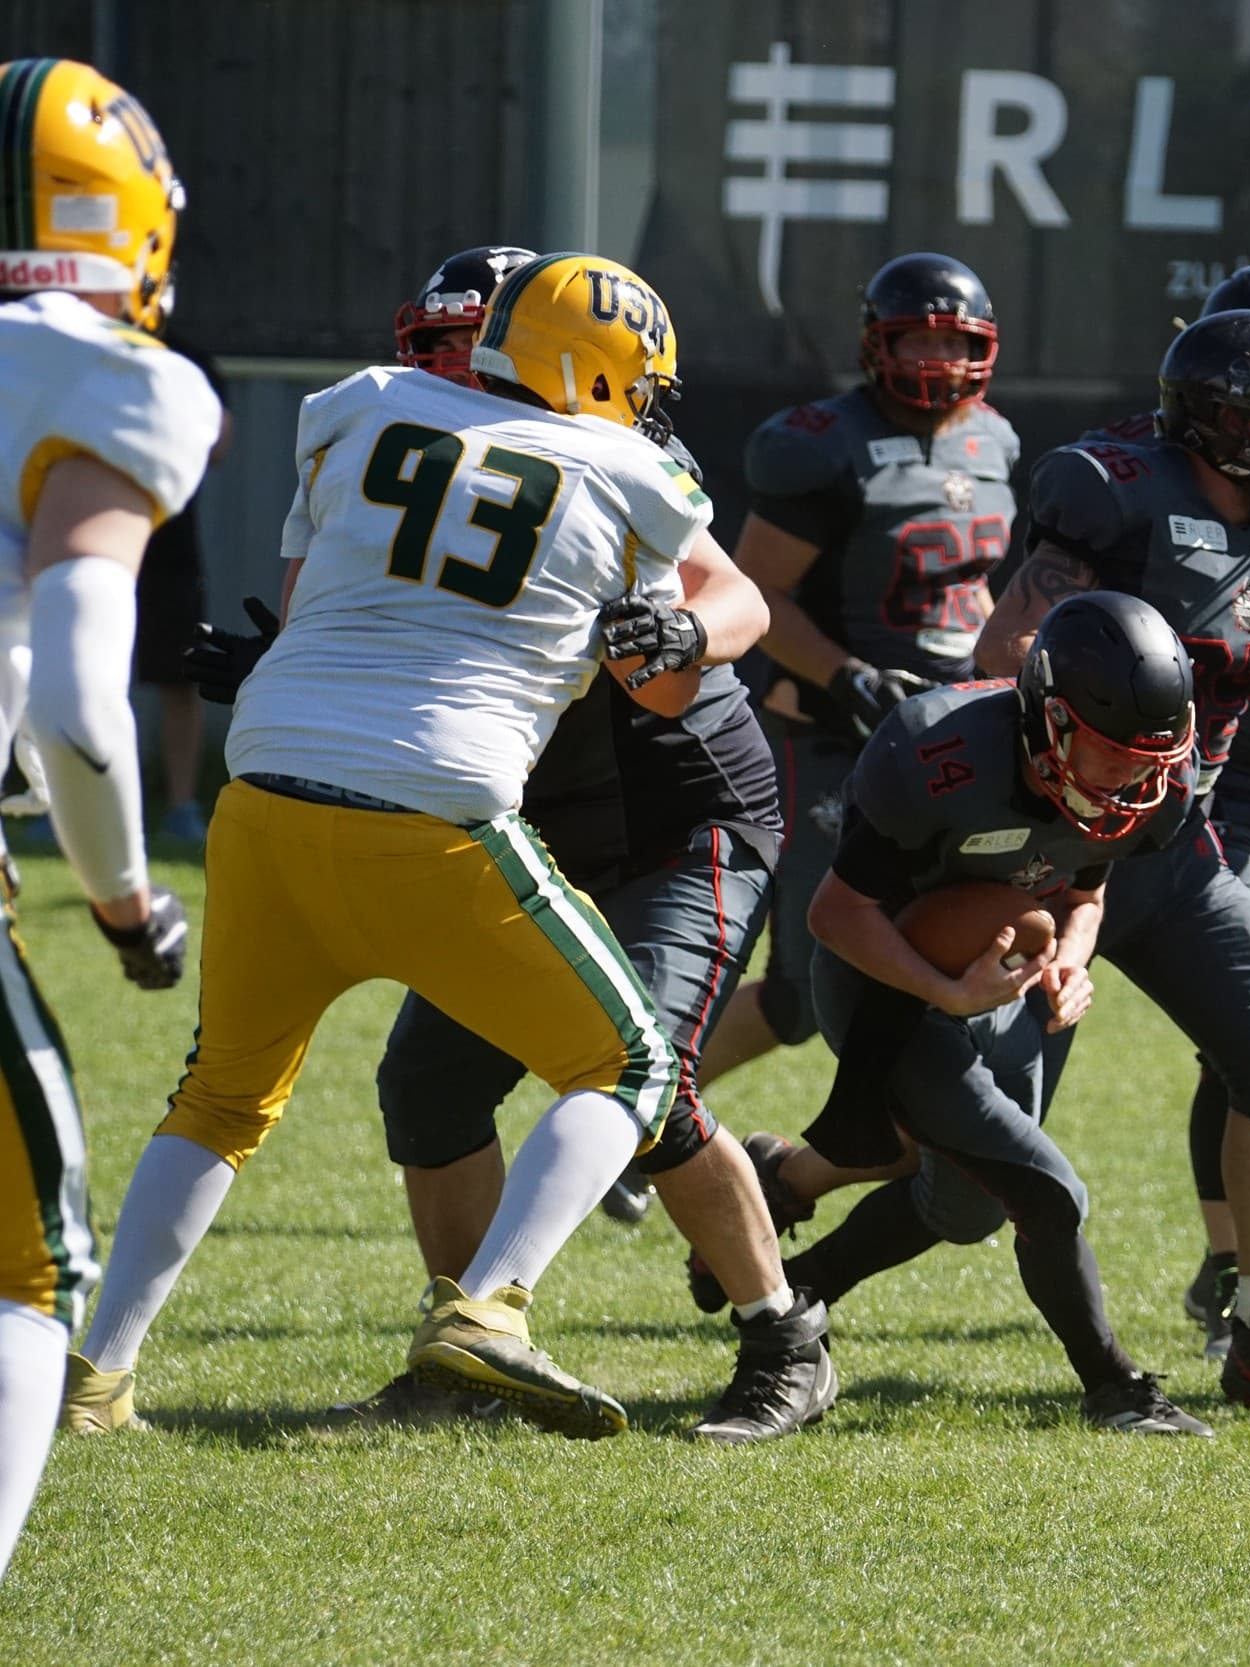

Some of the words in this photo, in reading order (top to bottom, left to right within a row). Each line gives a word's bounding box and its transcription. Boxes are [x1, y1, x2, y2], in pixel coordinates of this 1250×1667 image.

[1166, 260, 1225, 297] zu
[360, 421, 566, 610] 93
[918, 735, 976, 798] 14
